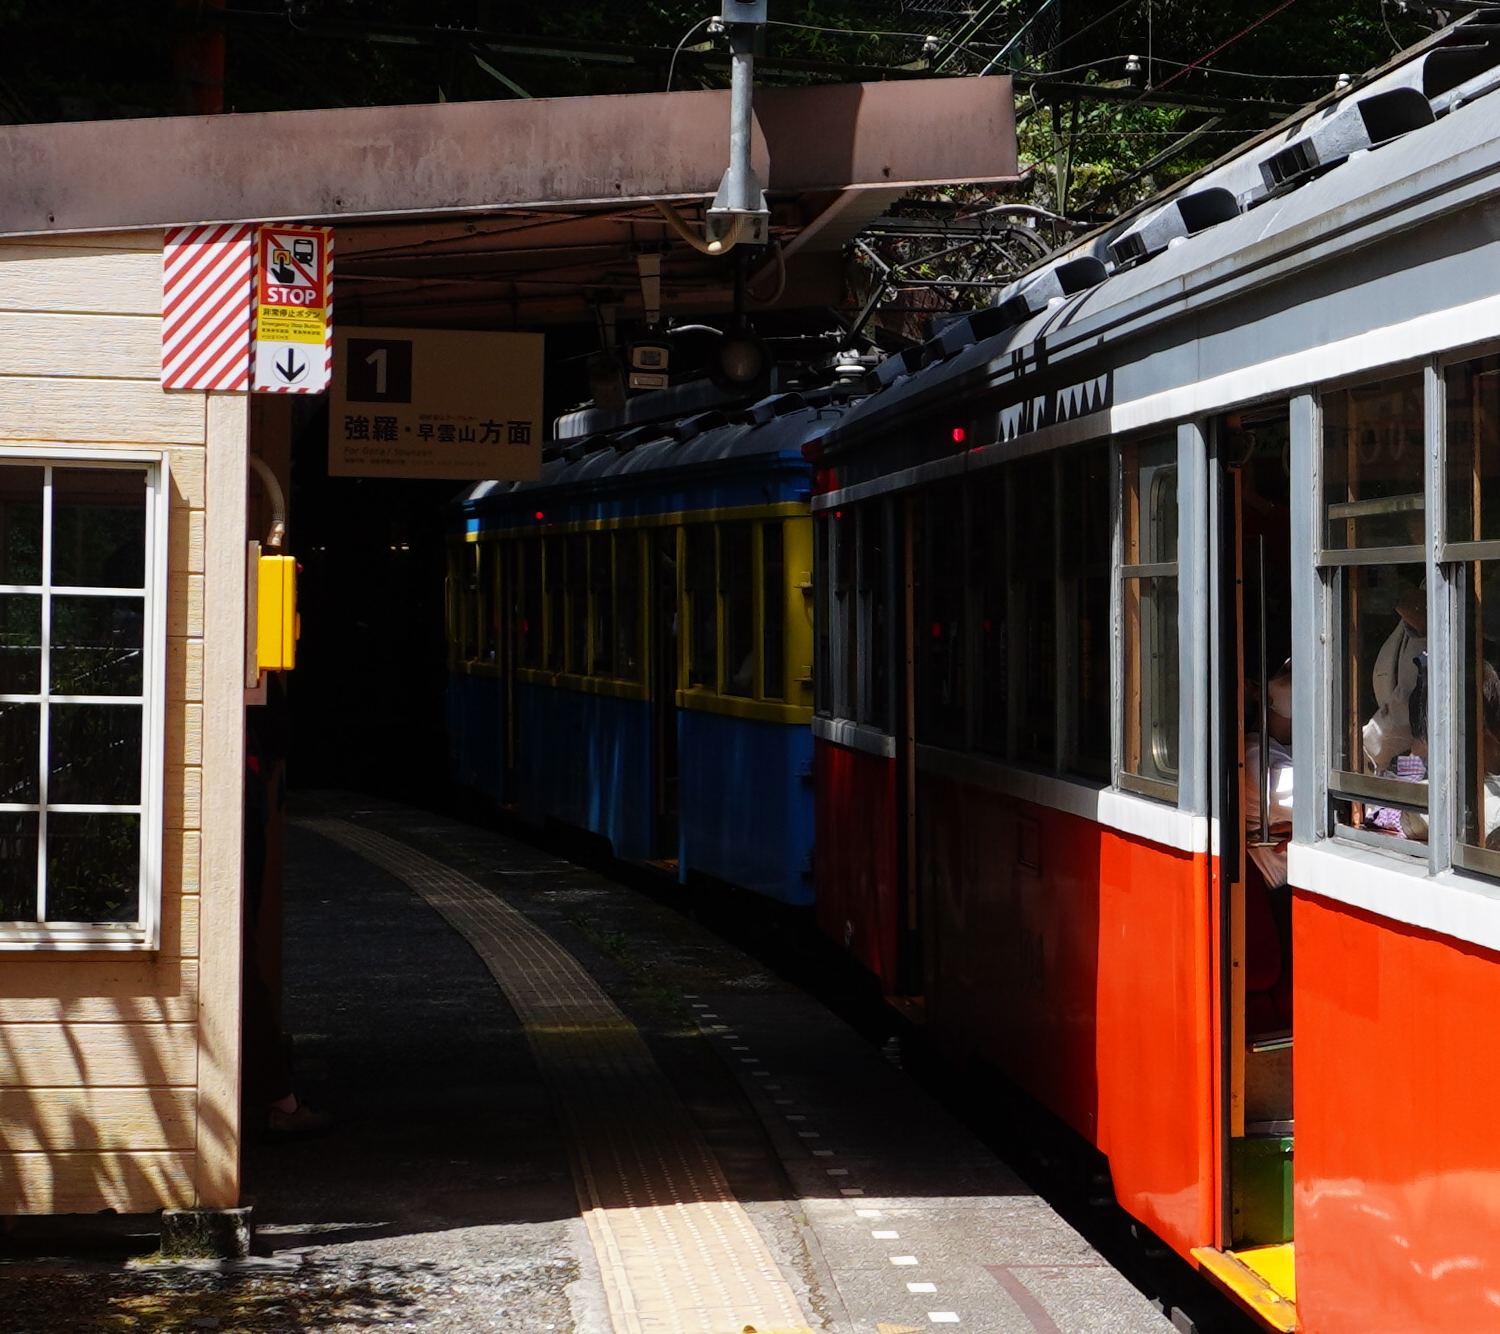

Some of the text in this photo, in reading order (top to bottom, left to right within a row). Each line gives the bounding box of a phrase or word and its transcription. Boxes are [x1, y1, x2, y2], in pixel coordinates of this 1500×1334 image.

[267, 287, 316, 305] STOP
[365, 348, 387, 394] 1
[344, 414, 532, 446] 強羅・早雲山方面
